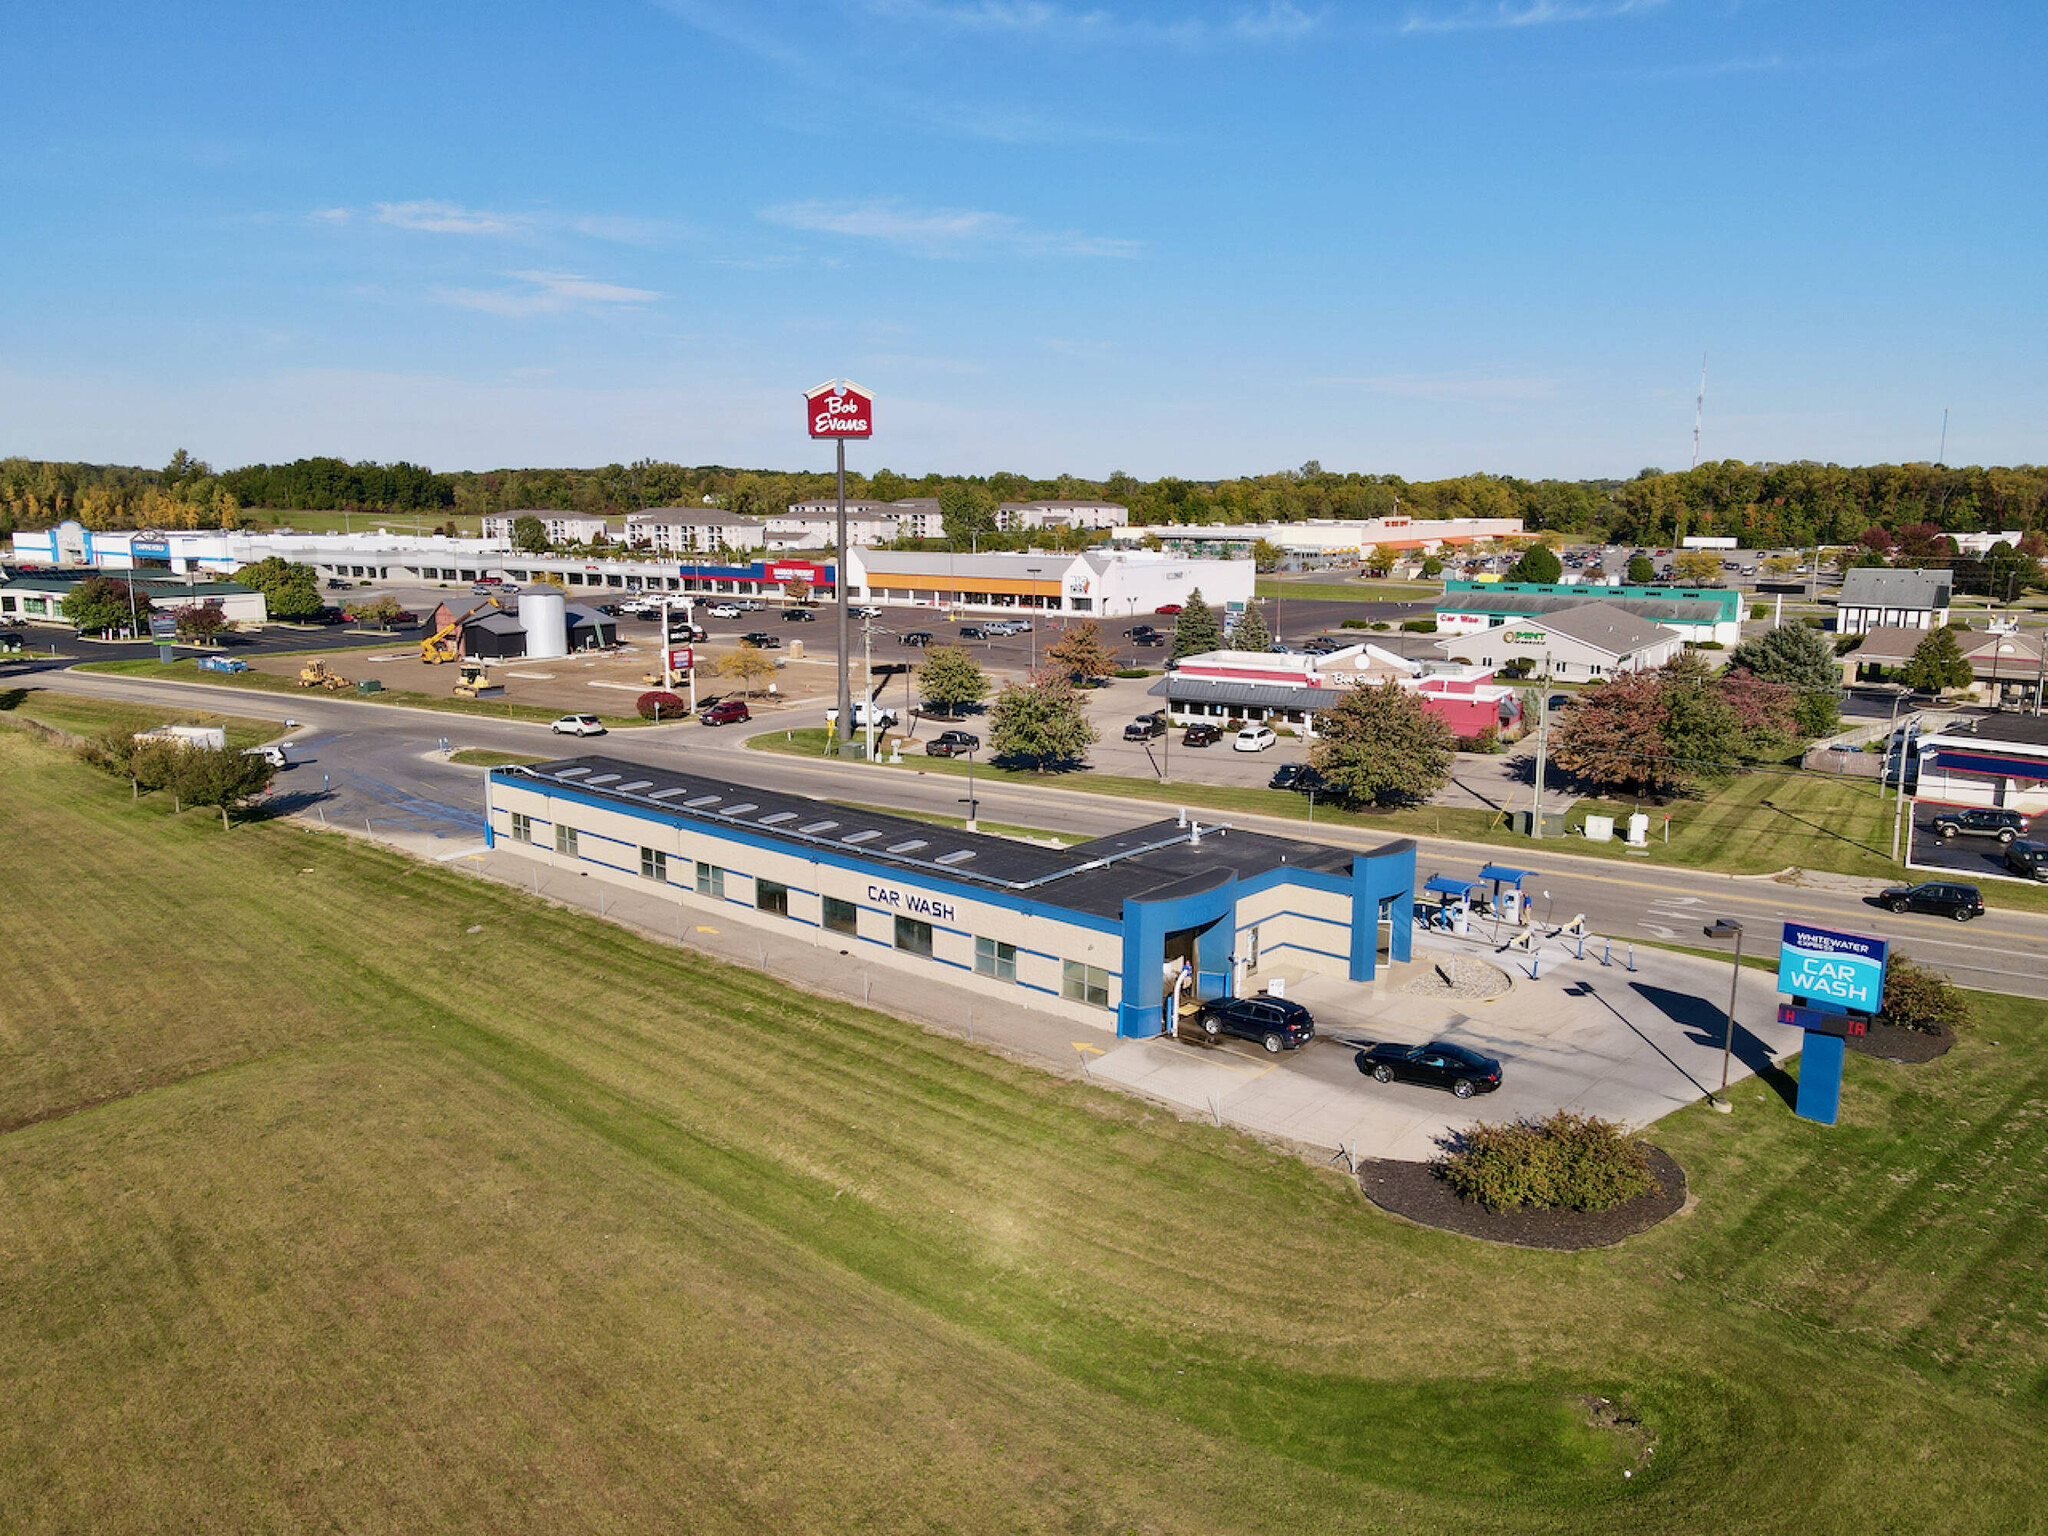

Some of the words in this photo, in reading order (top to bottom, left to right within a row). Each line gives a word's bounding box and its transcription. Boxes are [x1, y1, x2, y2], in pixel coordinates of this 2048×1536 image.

[824, 396, 858, 414] Bob
[815, 412, 868, 433] Evans
[868, 885, 901, 907] CAR
[905, 893, 955, 921] WASH
[1796, 932, 1870, 953] WHITEWATER
[1803, 958, 1856, 983] CAR
[1791, 971, 1867, 1002] WASH
